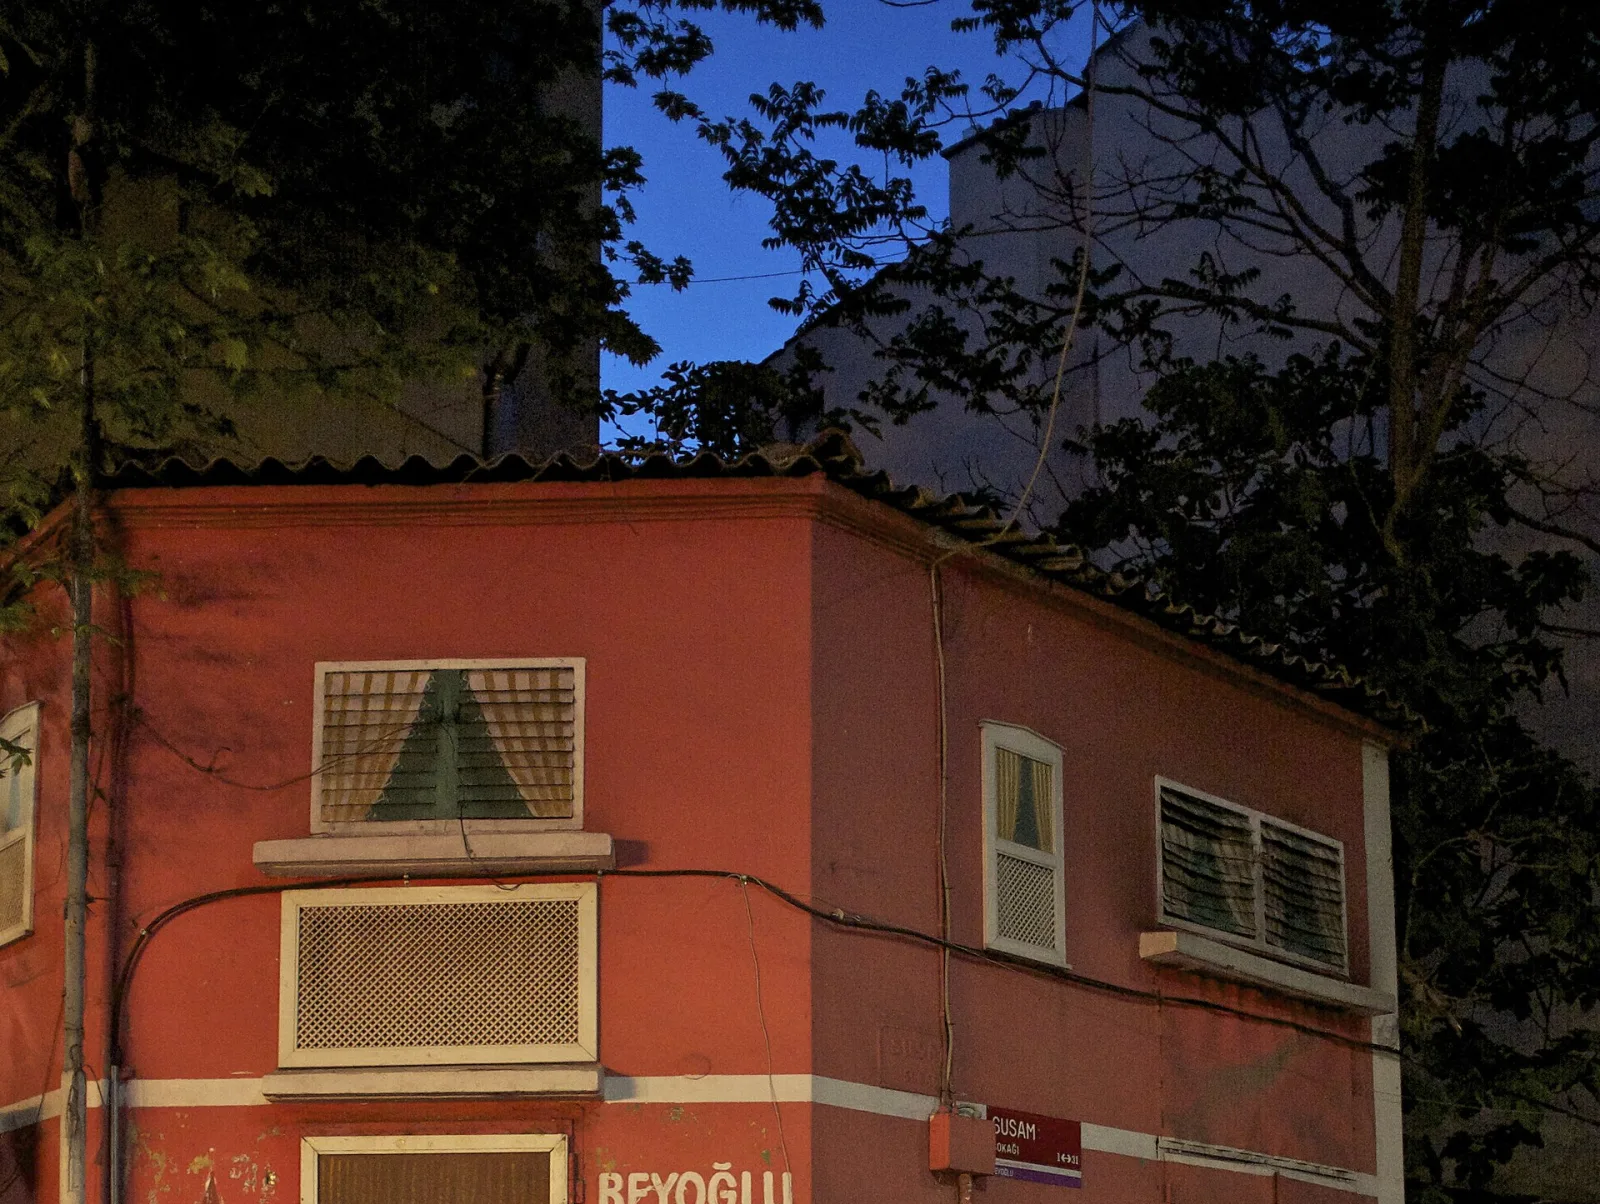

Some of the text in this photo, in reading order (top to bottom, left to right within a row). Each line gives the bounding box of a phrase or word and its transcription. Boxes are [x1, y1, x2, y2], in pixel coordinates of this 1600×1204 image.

[992, 1116, 1036, 1141] SUSAM
[995, 1142, 1020, 1156] OKAĞI
[994, 1167, 1014, 1177] EYOĞLU
